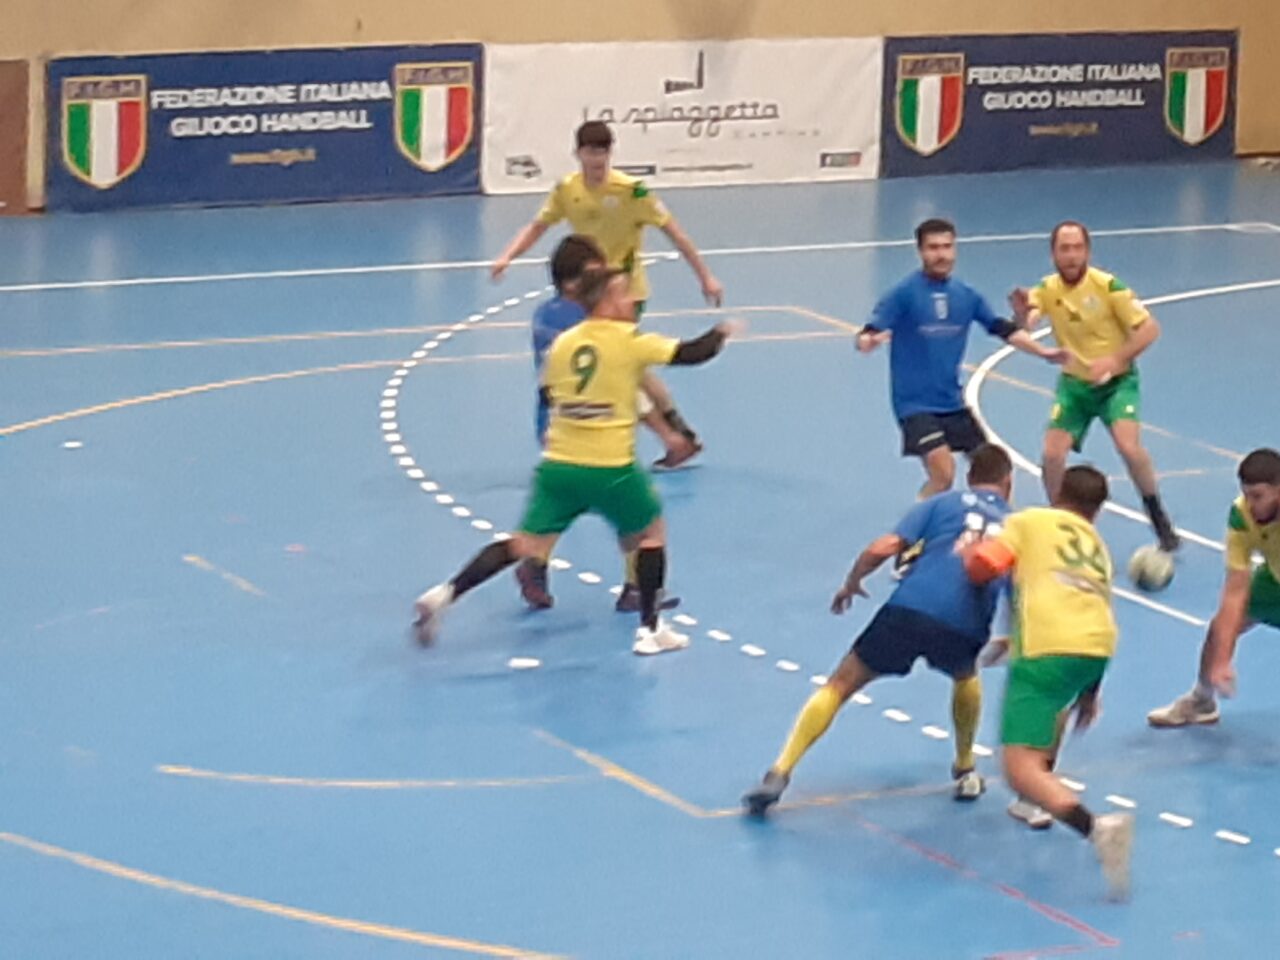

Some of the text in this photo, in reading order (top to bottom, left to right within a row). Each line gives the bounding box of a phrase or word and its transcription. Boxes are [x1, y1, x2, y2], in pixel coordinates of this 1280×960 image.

[966, 65, 1084, 85] FEDERAZIONE
[1087, 62, 1161, 81] ITALIANA
[151, 85, 297, 109] FEDERAZIONE
[300, 80, 393, 103] ITALIANA
[982, 88, 1145, 110] GIUOCO HANDBALL
[170, 109, 374, 137] GIUOCO HANDBALL
[570, 345, 598, 395] 9
